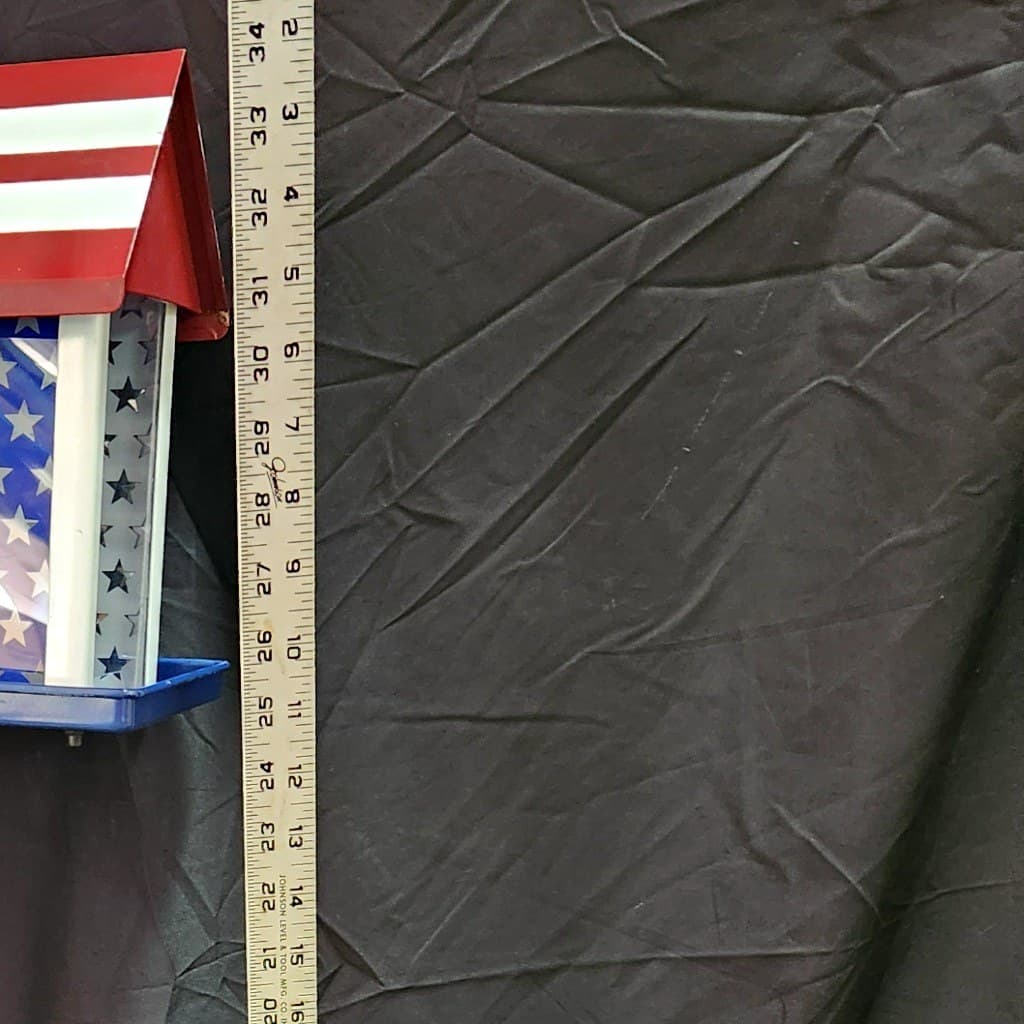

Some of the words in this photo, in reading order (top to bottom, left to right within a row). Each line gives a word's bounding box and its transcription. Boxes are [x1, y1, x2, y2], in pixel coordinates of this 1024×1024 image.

[282, 18, 298, 36] 2
[249, 22, 265, 62] 34
[283, 103, 299, 120] 3
[250, 106, 266, 146] 33
[284, 186, 299, 202] 4
[251, 188, 267, 227] 32
[284, 266, 299, 281] 5
[252, 276, 267, 306] 31
[284, 342, 299, 357] 6
[253, 345, 268, 382] 30
[285, 416, 299, 432] 7
[255, 420, 269, 456] 29
[285, 488, 299, 503] 8
[256, 492, 270, 527] 28
[257, 561, 271, 595] 27
[286, 559, 300, 574] 9
[258, 630, 272, 661] 26
[287, 635, 301, 659] 10
[259, 696, 273, 727] 25
[288, 701, 302, 720] 11
[260, 761, 274, 790] 24
[289, 764, 302, 788] 12
[261, 822, 274, 851] 23
[290, 825, 303, 848] 13
[262, 882, 275, 911] 22
[279, 875, 287, 917] JOHNSON
[291, 885, 304, 907] 14
[279, 920, 287, 942] LEVEL
[264, 947, 276, 969] 21
[292, 944, 305, 966] 15
[265, 998, 277, 1024] 20
[293, 1001, 305, 1023] 16
